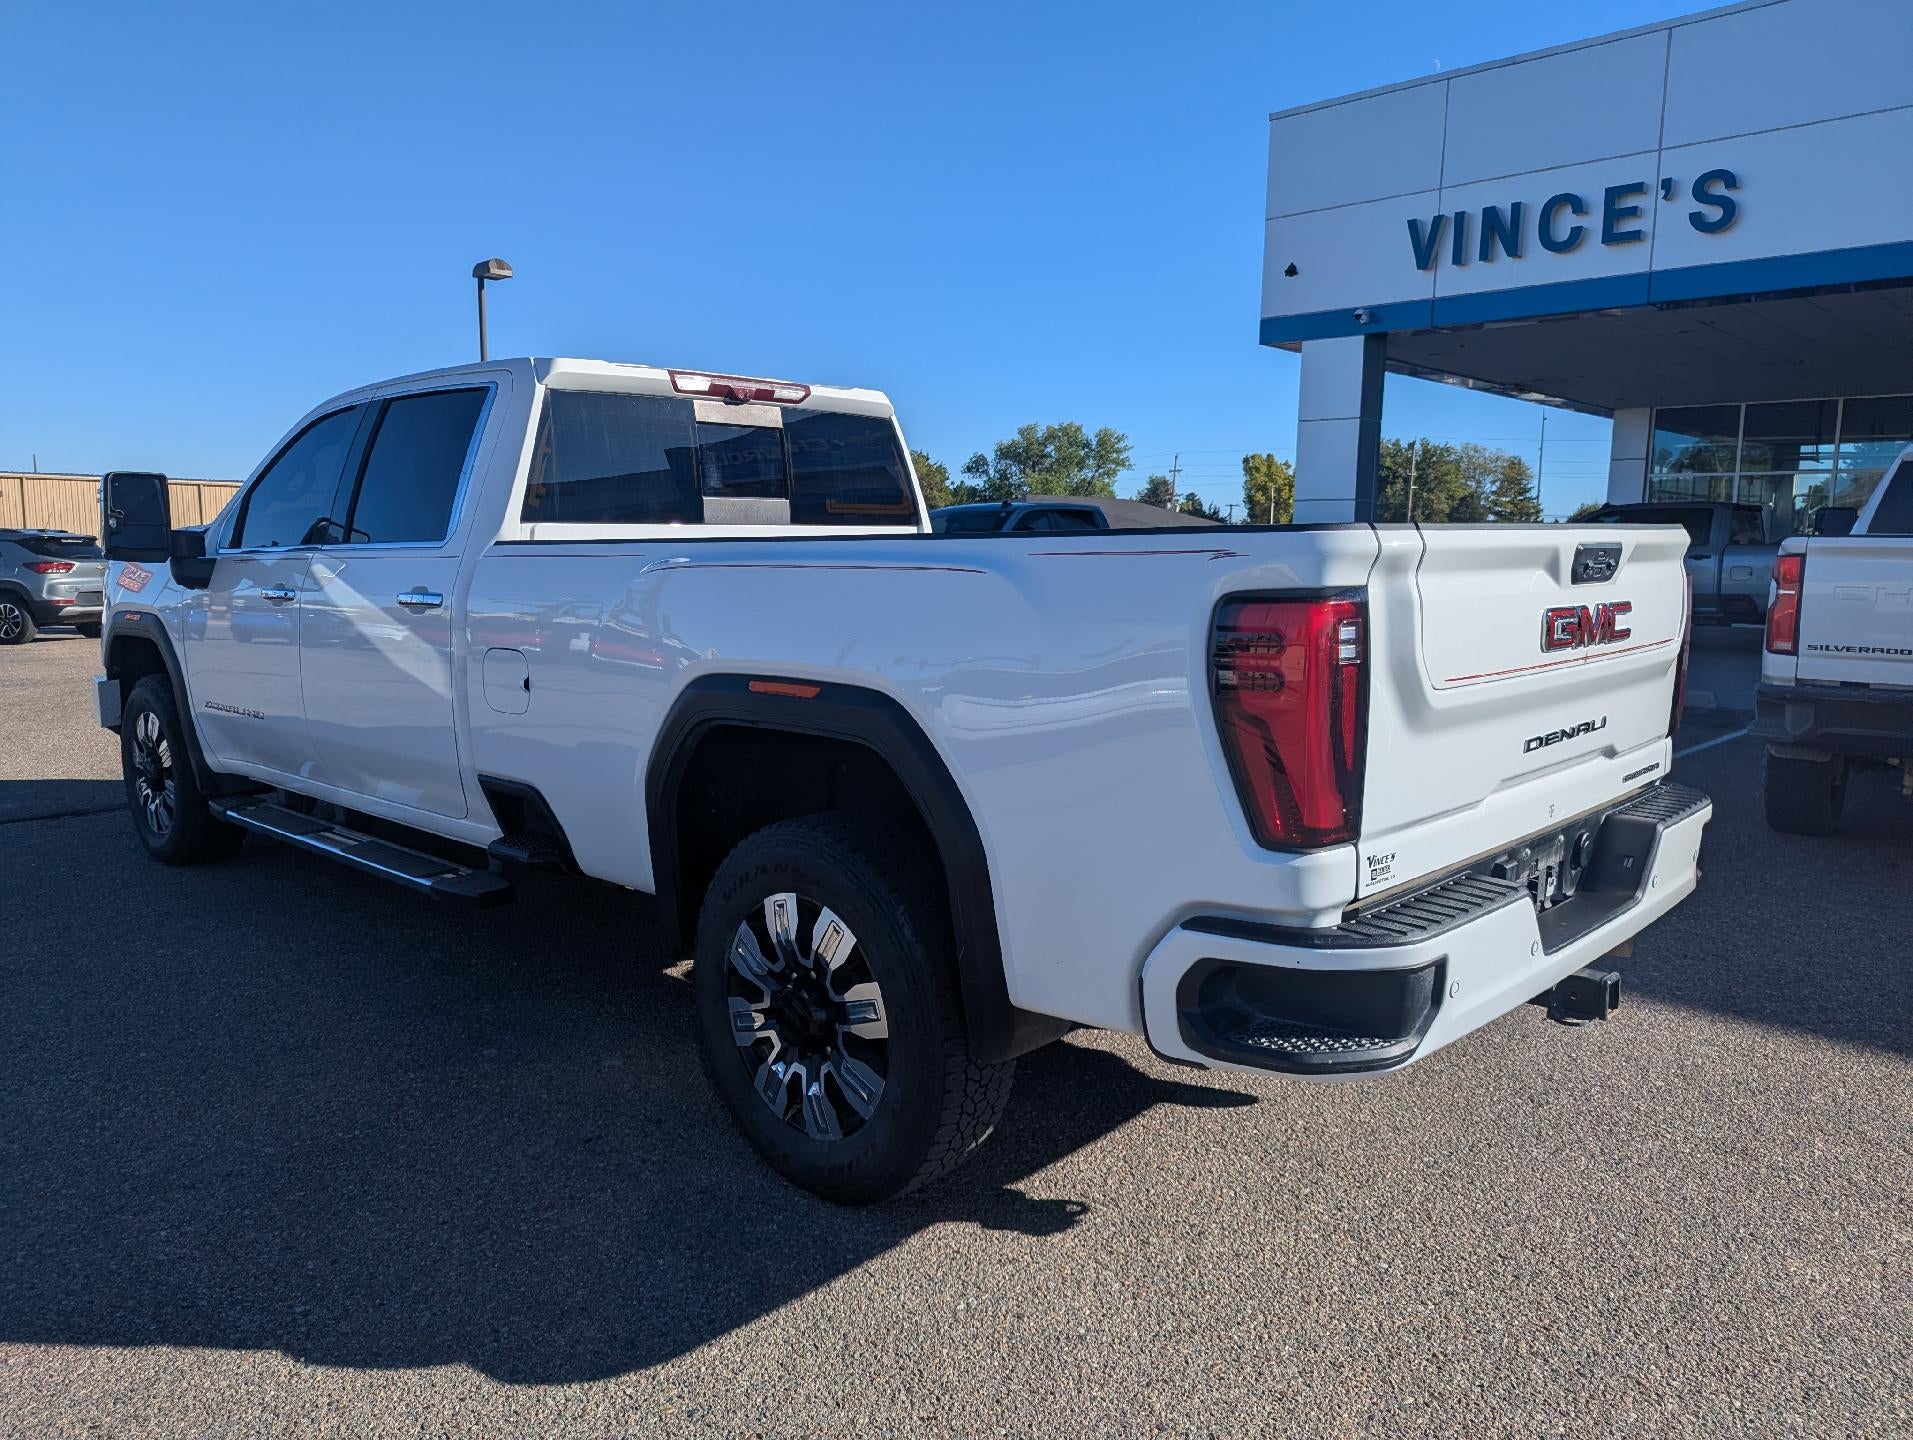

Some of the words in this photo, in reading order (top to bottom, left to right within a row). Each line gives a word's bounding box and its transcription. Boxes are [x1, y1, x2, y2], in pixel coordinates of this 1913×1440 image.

[1406, 168, 1741, 271] VINCE'S
[1540, 601, 1632, 653] GMC
[1807, 644, 1912, 656] SILVERADO
[1523, 715, 1607, 754] DENALI
